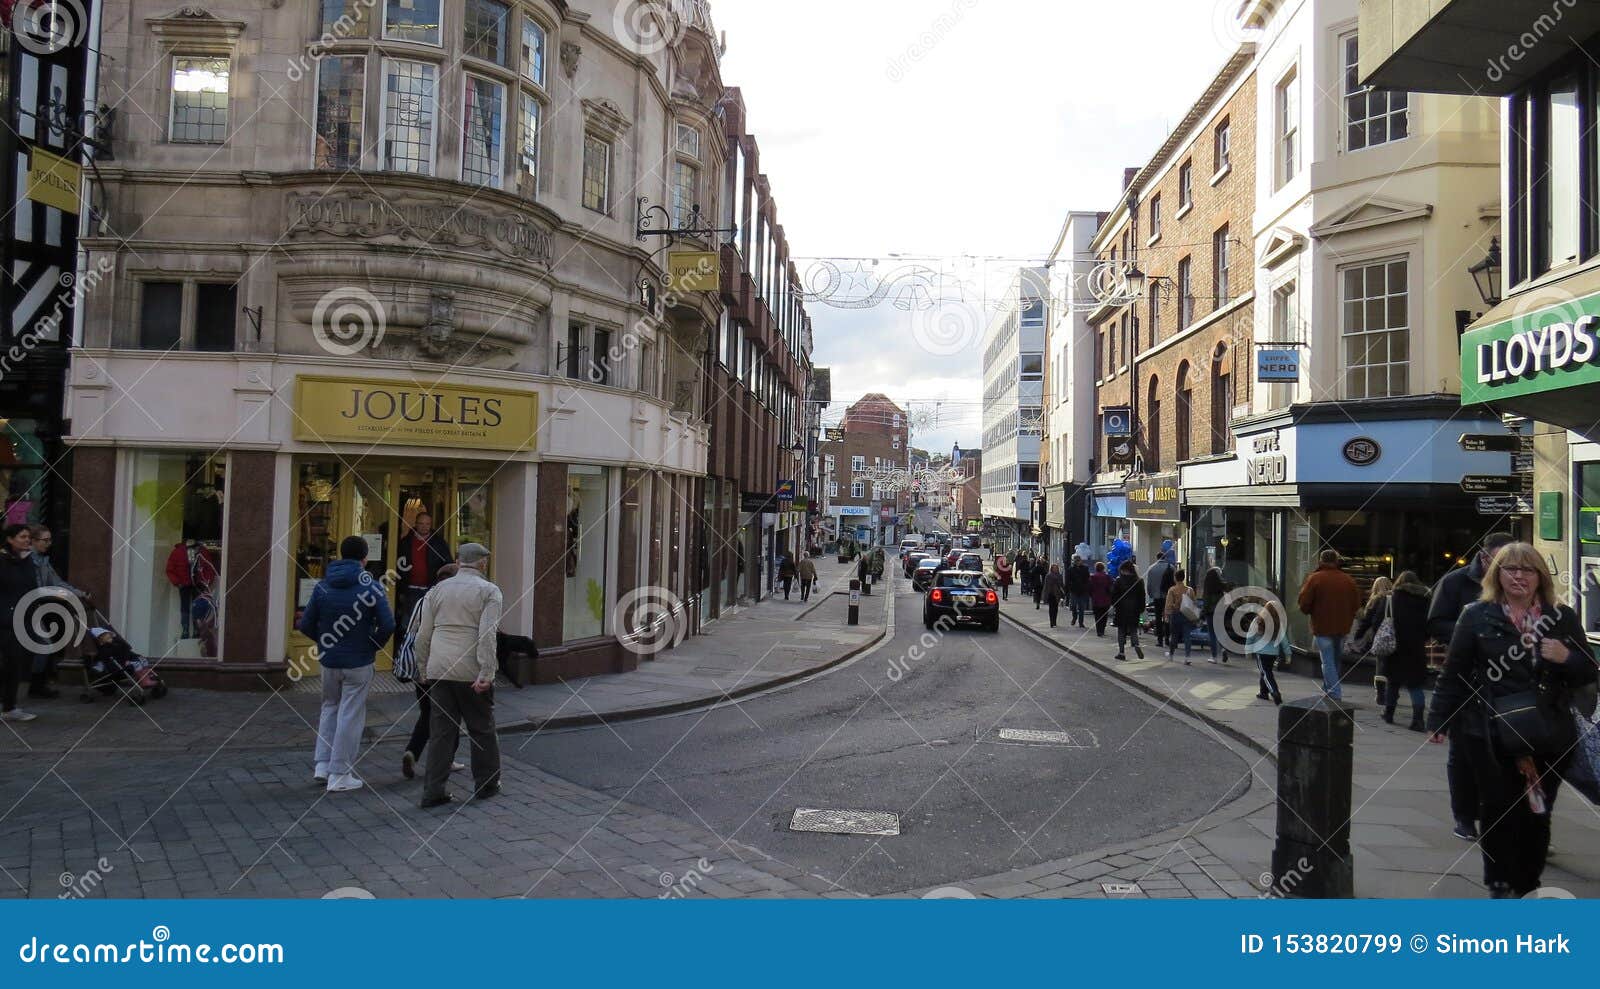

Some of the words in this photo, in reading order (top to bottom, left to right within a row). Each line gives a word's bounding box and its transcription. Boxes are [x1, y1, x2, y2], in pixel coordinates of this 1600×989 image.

[298, 201, 359, 226] ROYAL
[1477, 315, 1594, 383] LLOYDS
[1260, 364, 1297, 372] NERO
[341, 389, 503, 427] JOULES
[1247, 455, 1286, 484] NERO
